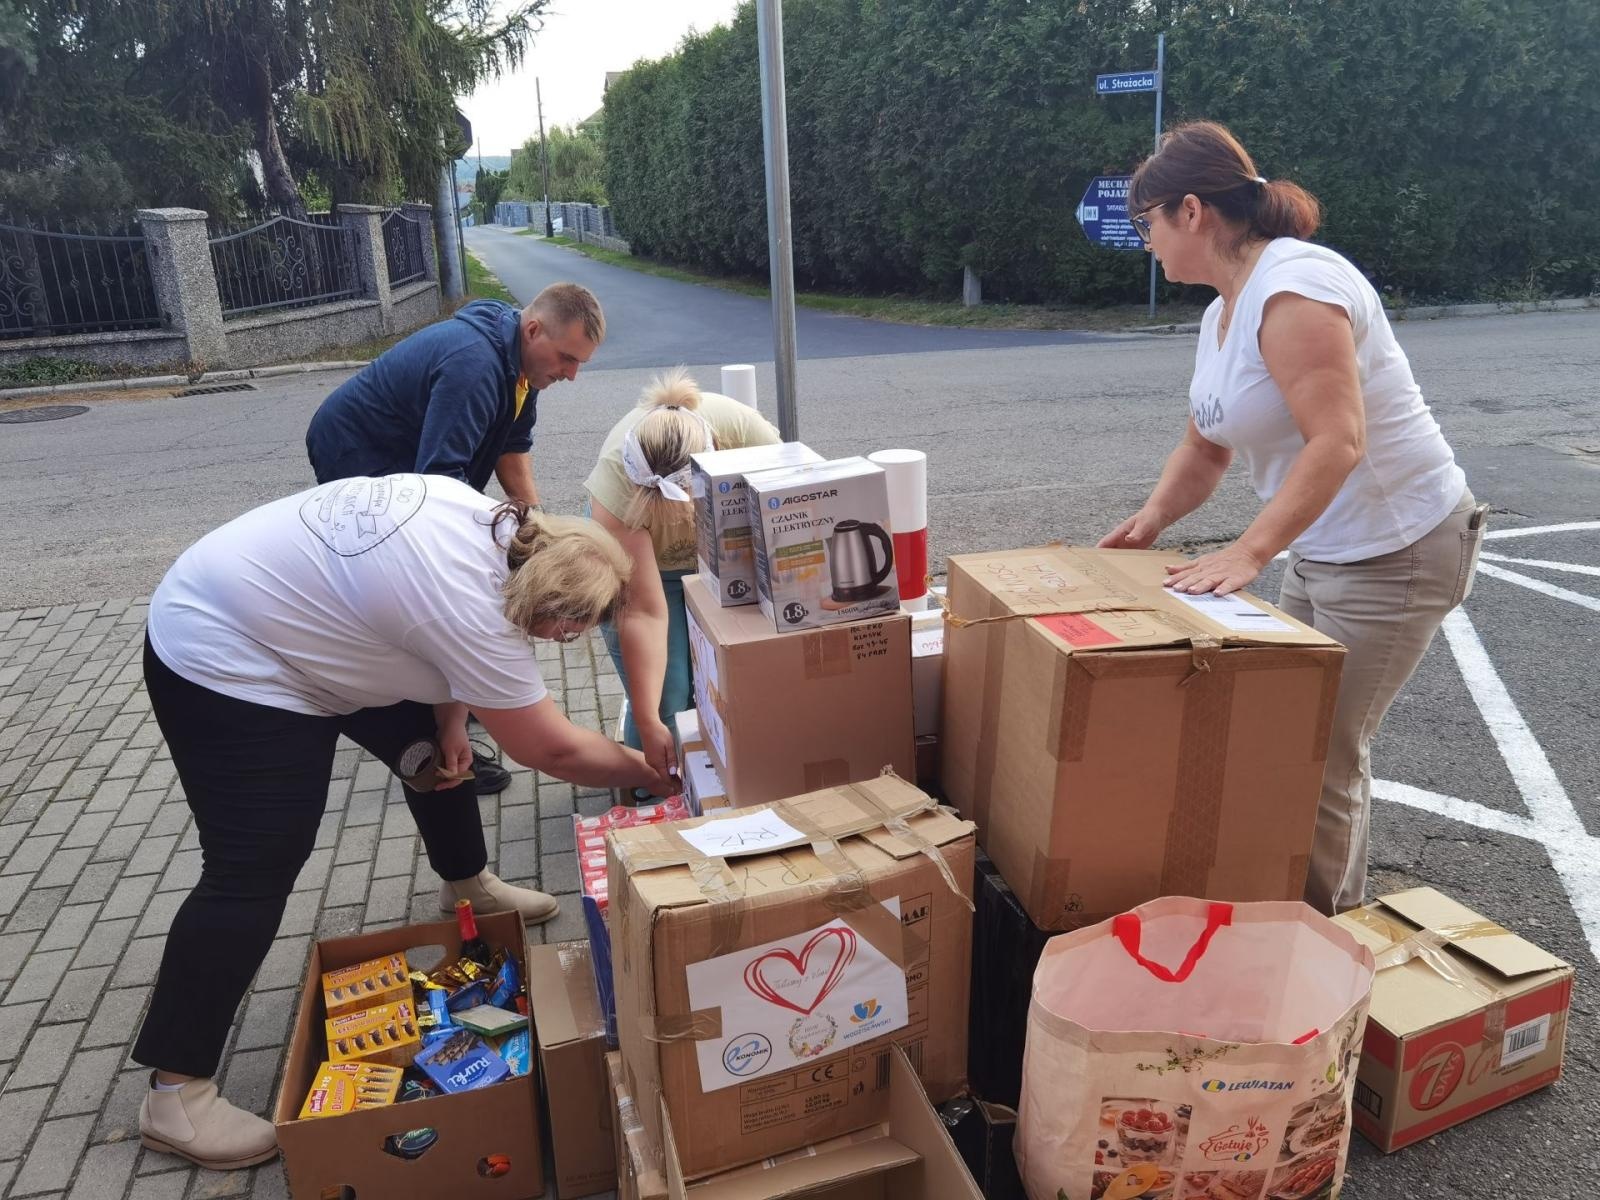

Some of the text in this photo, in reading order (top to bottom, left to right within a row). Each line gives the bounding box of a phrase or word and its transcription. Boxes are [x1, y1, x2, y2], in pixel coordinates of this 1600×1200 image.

[1099, 76, 1153, 90] ul. Strażacka
[782, 489, 838, 506] AIGOSTAR
[771, 511, 809, 524] CZAJNIK
[772, 516, 835, 535] ELEKTRYCZNY
[447, 1057, 492, 1087] Rurki
[1421, 1050, 1454, 1105] 7
[1431, 1053, 1460, 1098] DAYS
[1228, 1079, 1295, 1092] LEWIATAN
[1213, 1139, 1253, 1154] Gotuje
